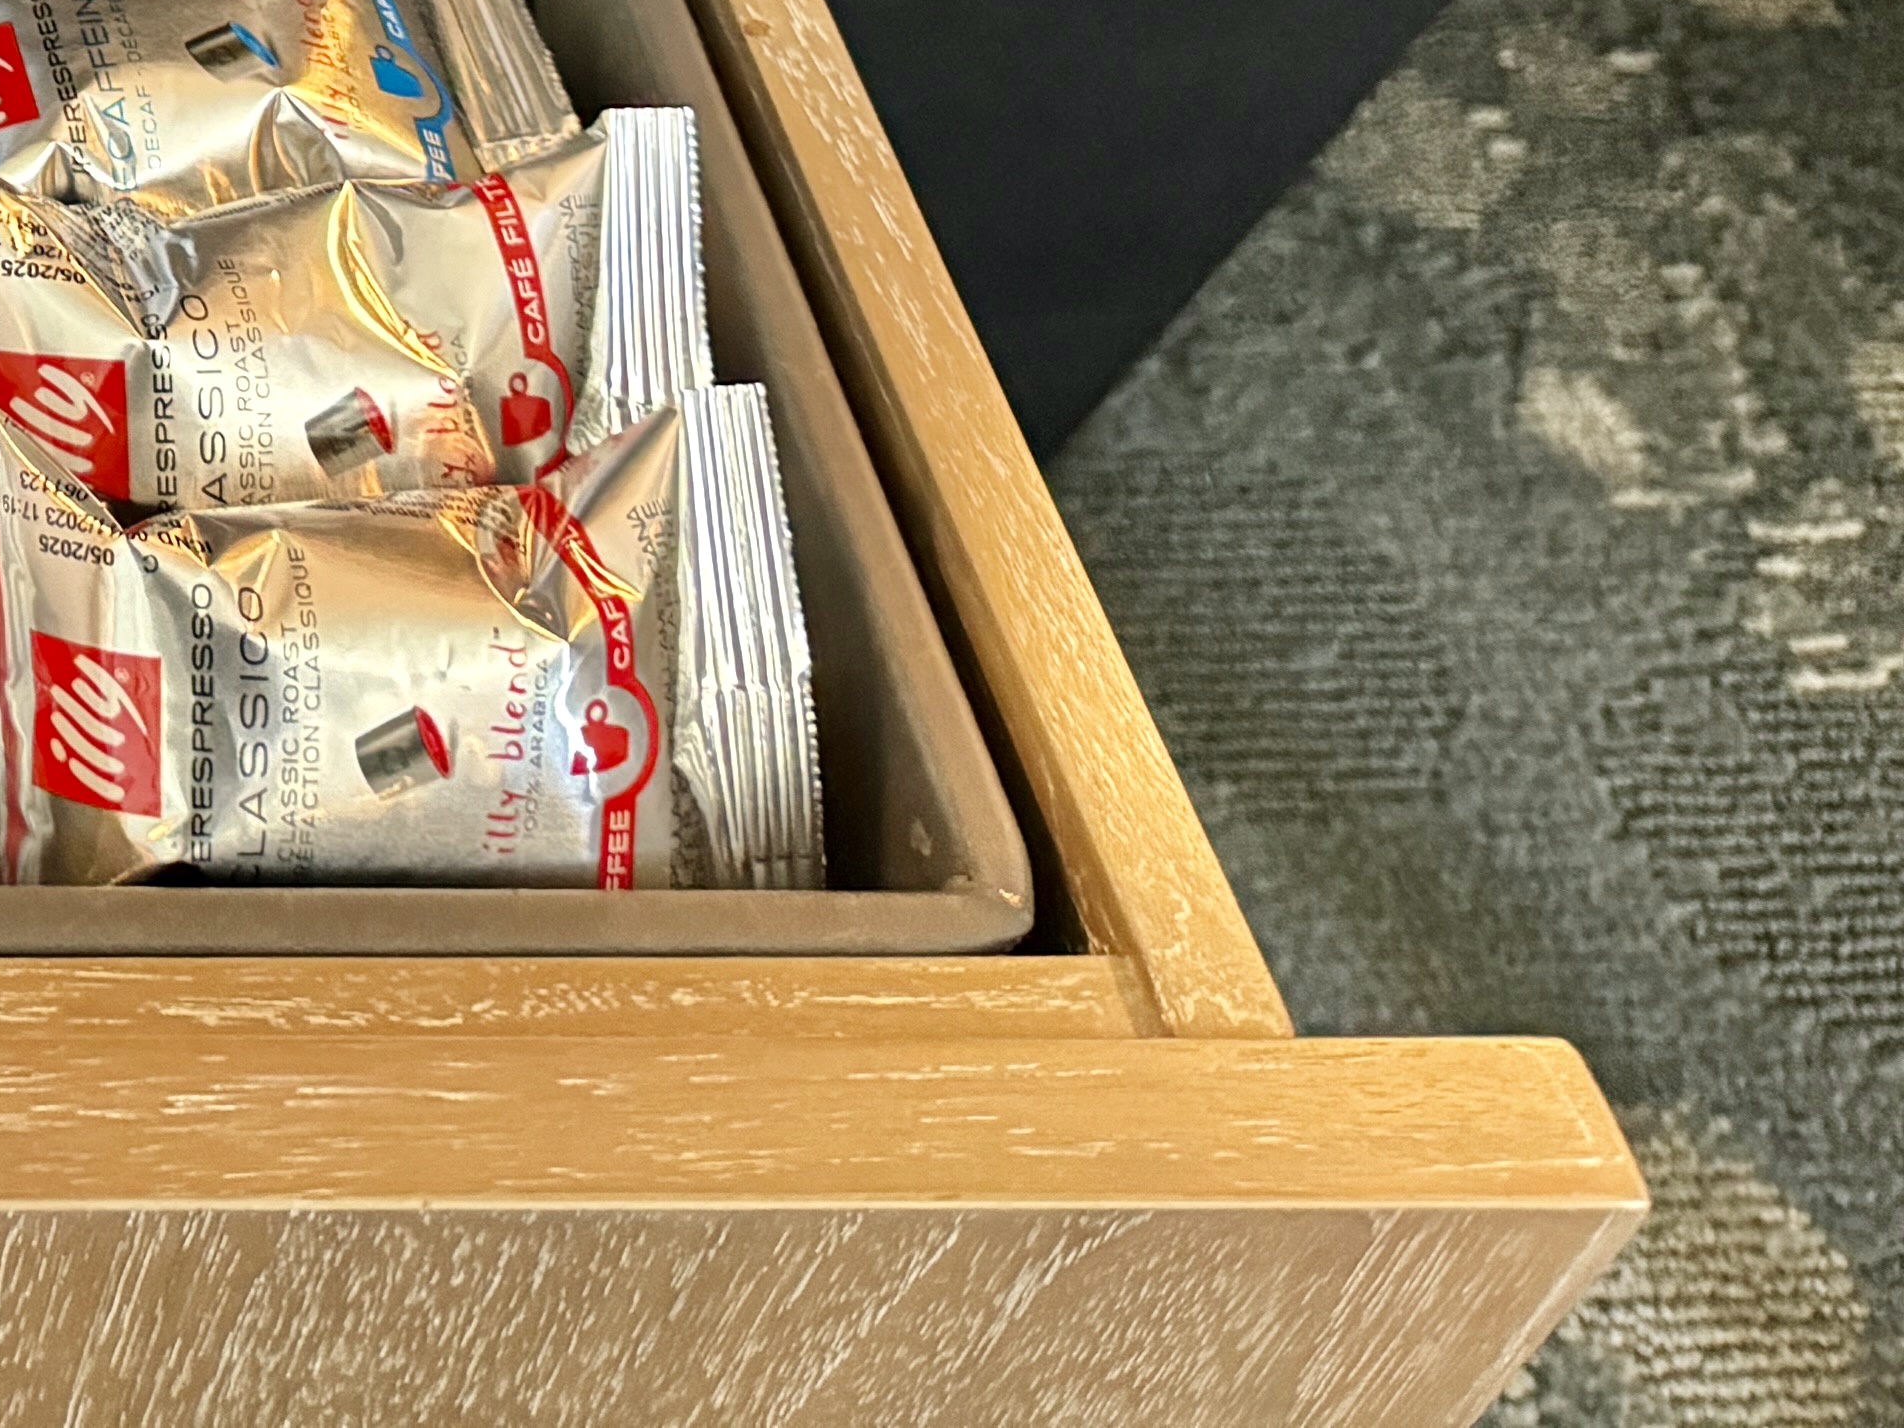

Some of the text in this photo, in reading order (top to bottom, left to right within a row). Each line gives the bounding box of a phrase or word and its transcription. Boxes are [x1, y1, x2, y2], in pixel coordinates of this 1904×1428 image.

[1, 260, 86, 284] 05/2025
[508, 257, 546, 345] CAFÉ
[219, 257, 272, 400] CLASSIQUE
[226, 319, 256, 413] ROAST
[2, 494, 38, 521] 17:19
[39, 534, 115, 567] 05/2025
[279, 621, 300, 725] ROAST
[288, 546, 320, 712] CLASSIQUE
[601, 597, 632, 670] CAF
[50, 654, 149, 804] illy
[482, 641, 528, 855] illy blend
[530, 659, 550, 769] ARABICA
